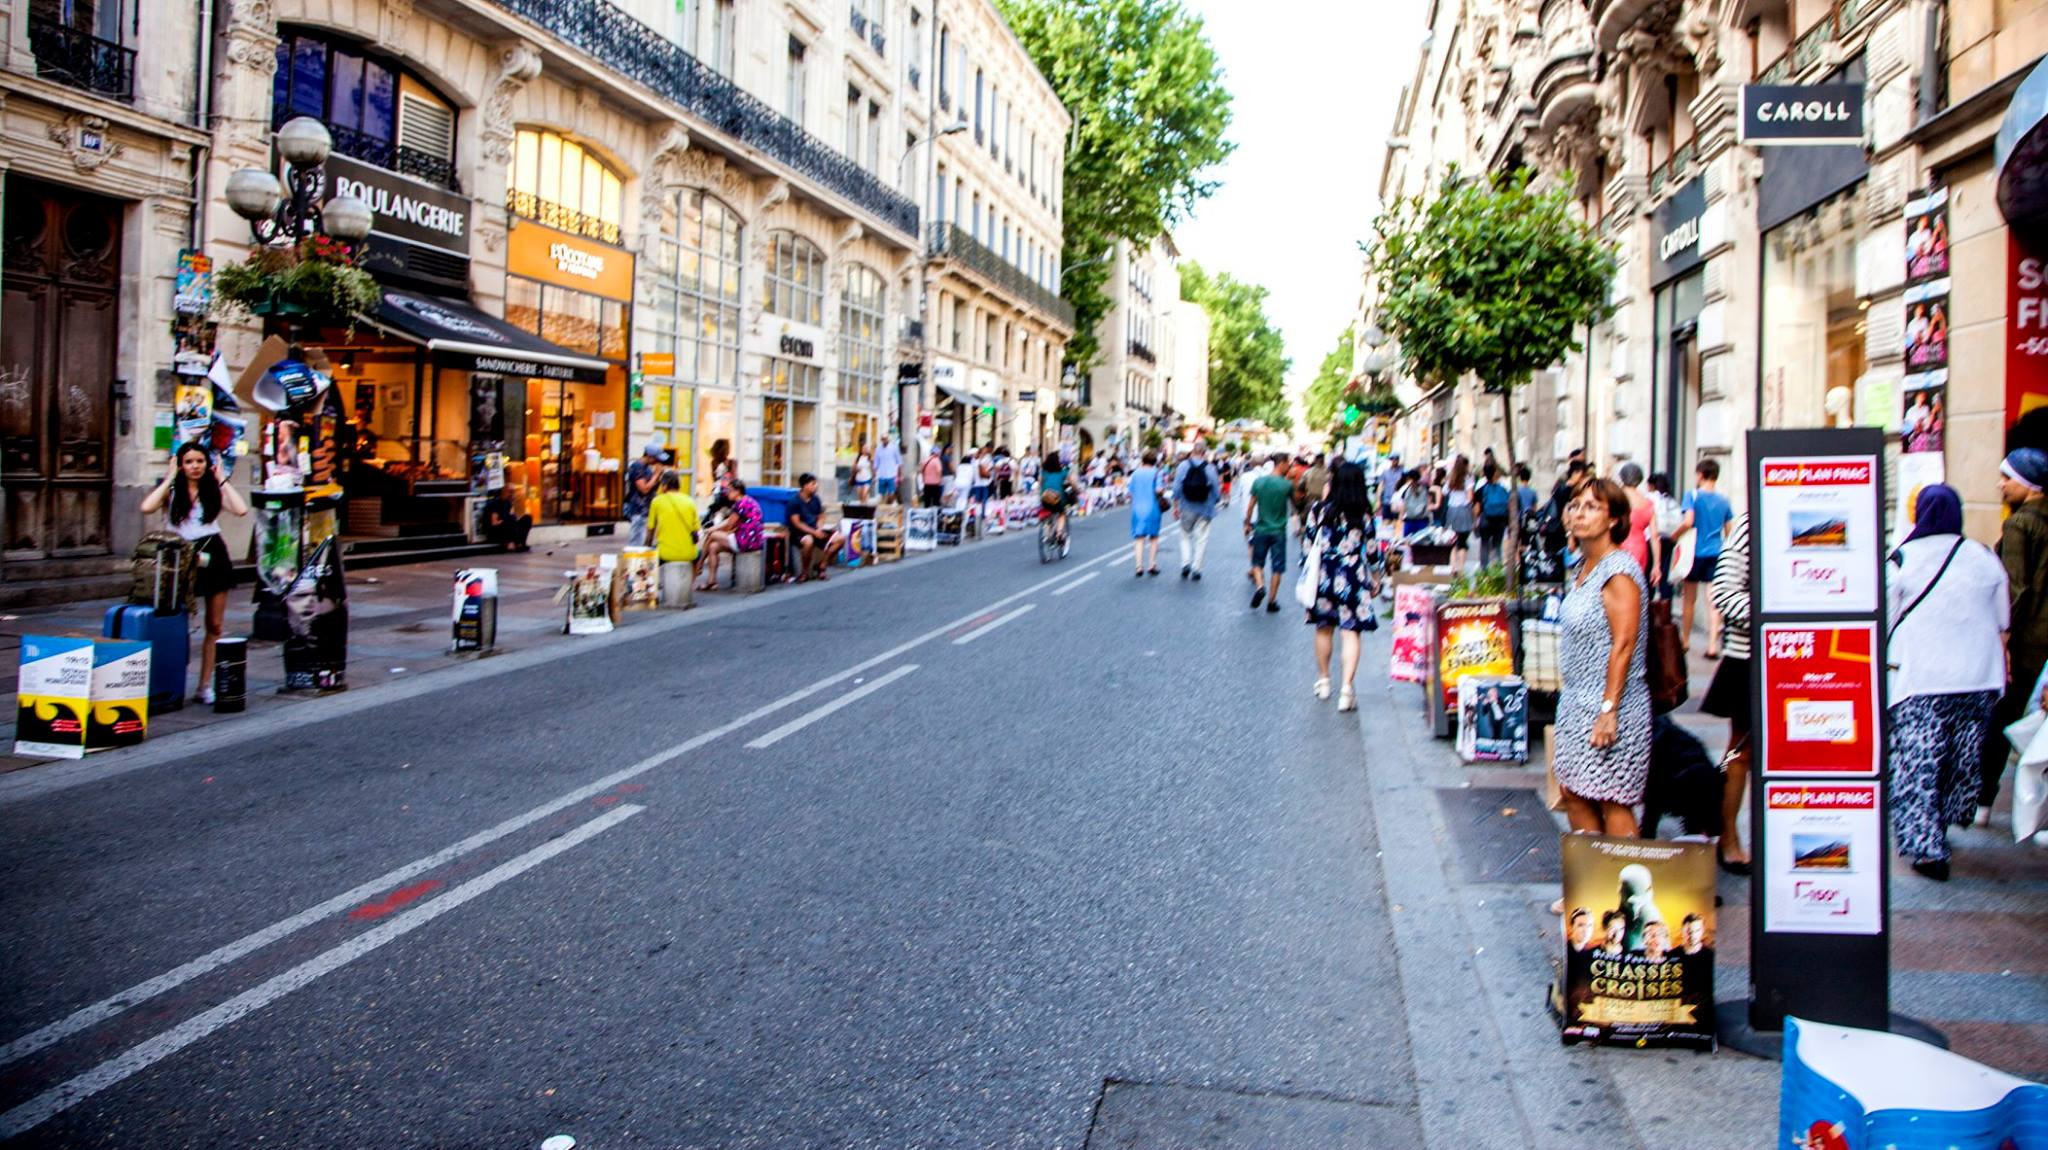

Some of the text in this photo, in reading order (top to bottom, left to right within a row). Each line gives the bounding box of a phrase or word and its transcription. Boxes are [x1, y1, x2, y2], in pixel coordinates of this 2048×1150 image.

[1756, 99, 1851, 123] CAROLL
[336, 176, 464, 237] BOULANGERIE
[1660, 216, 1700, 262] CAROLL
[780, 335, 814, 358] eram
[1767, 466, 1869, 482] BON PLAN FNAC
[1767, 631, 1816, 644] VENTE
[1771, 791, 1873, 805] BON PLAN FNAC
[1589, 958, 1684, 981] CHASSÉS
[1590, 976, 1684, 1001] CROISÉS
